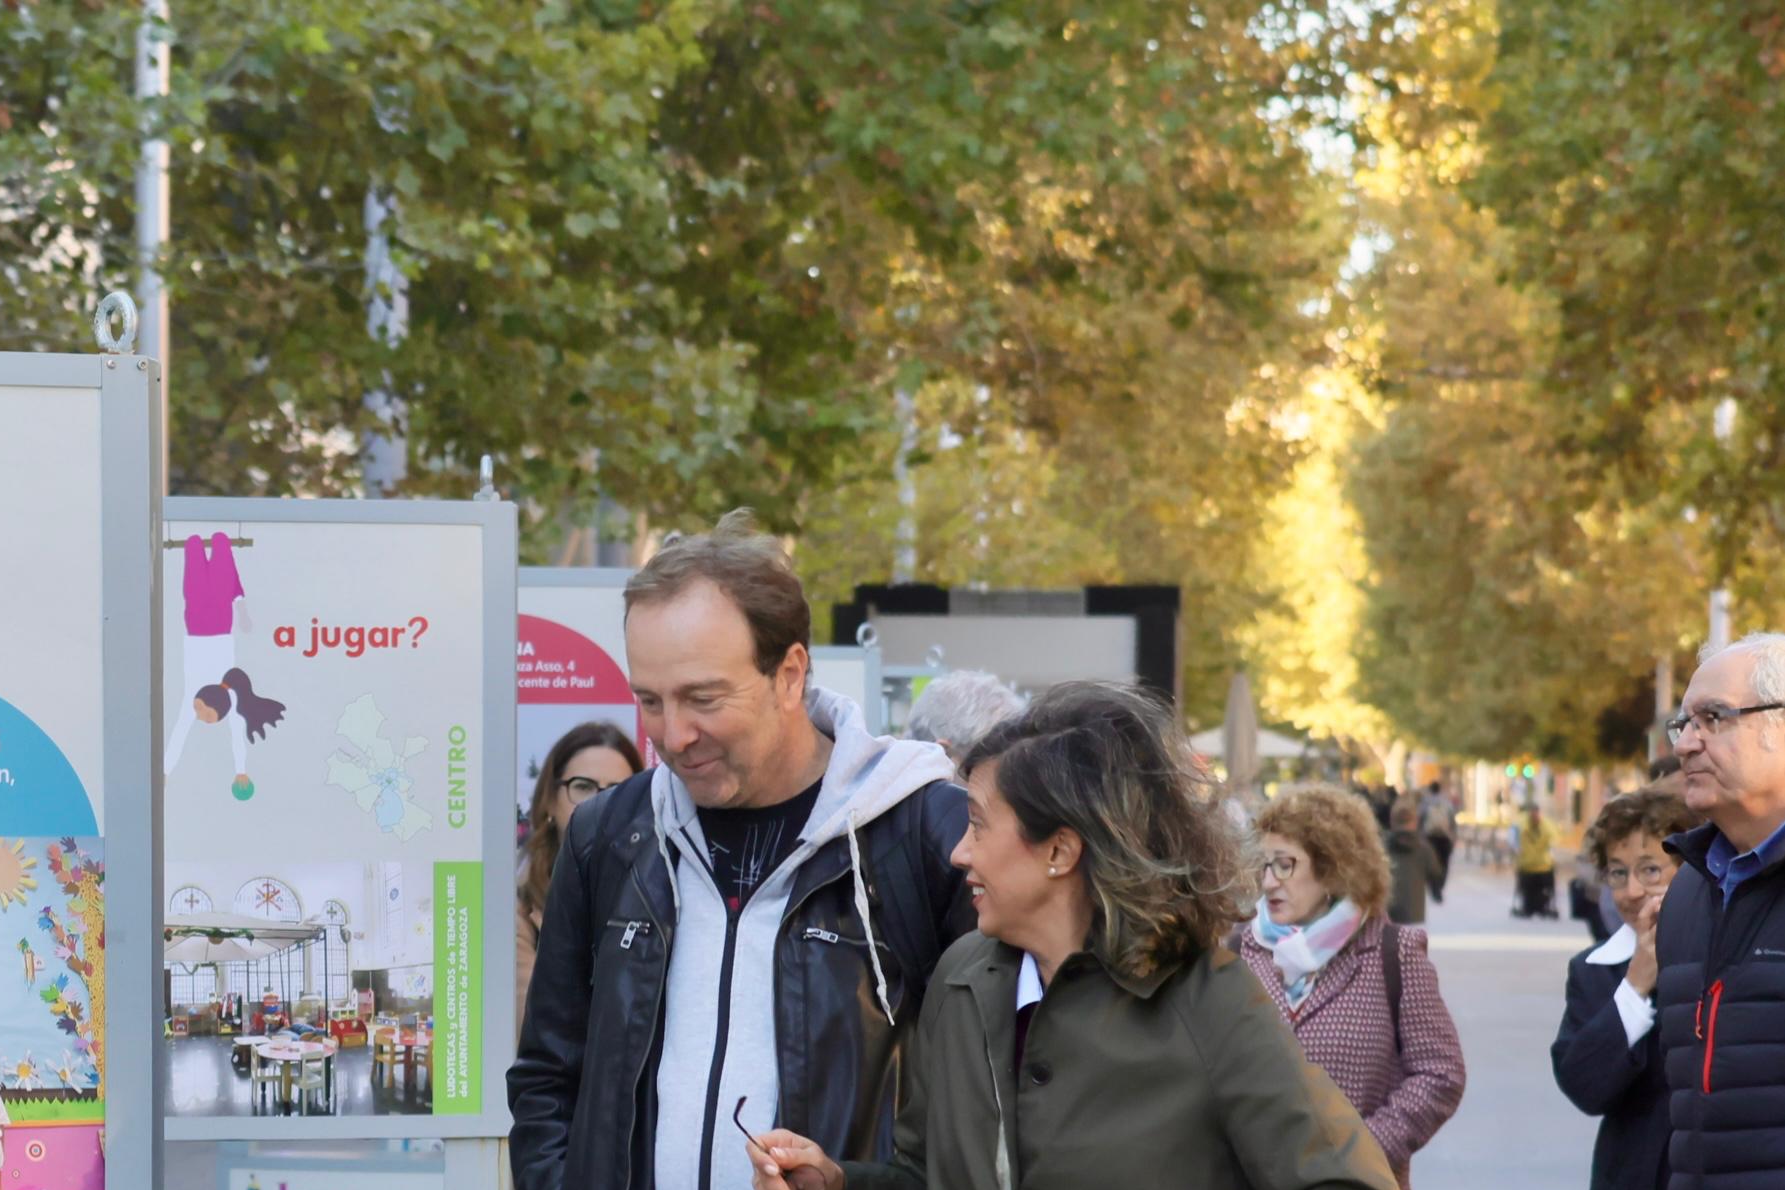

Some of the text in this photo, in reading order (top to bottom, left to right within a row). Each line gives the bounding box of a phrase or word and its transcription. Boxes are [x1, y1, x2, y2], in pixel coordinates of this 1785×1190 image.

[273, 616, 429, 658] a jugar?
[552, 676, 594, 688] de Paul
[567, 660, 575, 671] 4
[448, 724, 467, 829] CENTRO
[447, 874, 456, 904] LIBRE
[447, 906, 456, 948] TIEMPO
[447, 968, 456, 1019] CENTROS
[459, 906, 468, 1098] del AYUNTAMIENTO de ZARAGOZA
[447, 1032, 456, 1099] LUDOTECAS
